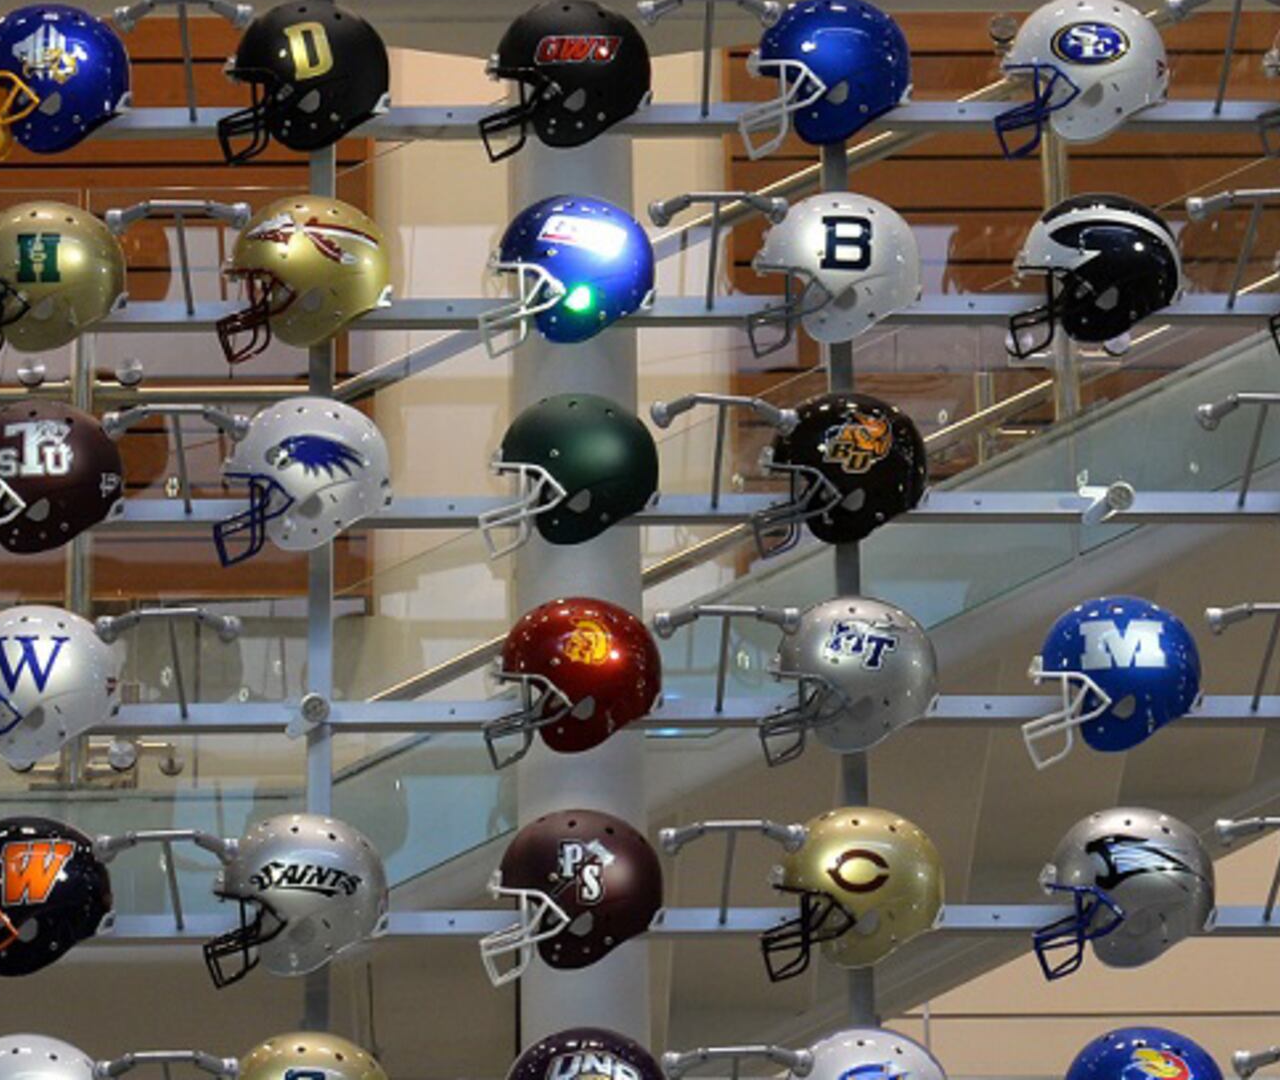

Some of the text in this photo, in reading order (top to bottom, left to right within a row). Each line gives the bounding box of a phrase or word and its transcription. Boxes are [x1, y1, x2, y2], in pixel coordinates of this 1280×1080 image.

[284, 22, 333, 80] D
[820, 215, 872, 270] B
[1079, 619, 1165, 669] M
[0, 841, 74, 904] W
[251, 861, 362, 897] SAINTS
[825, 849, 890, 892] C
